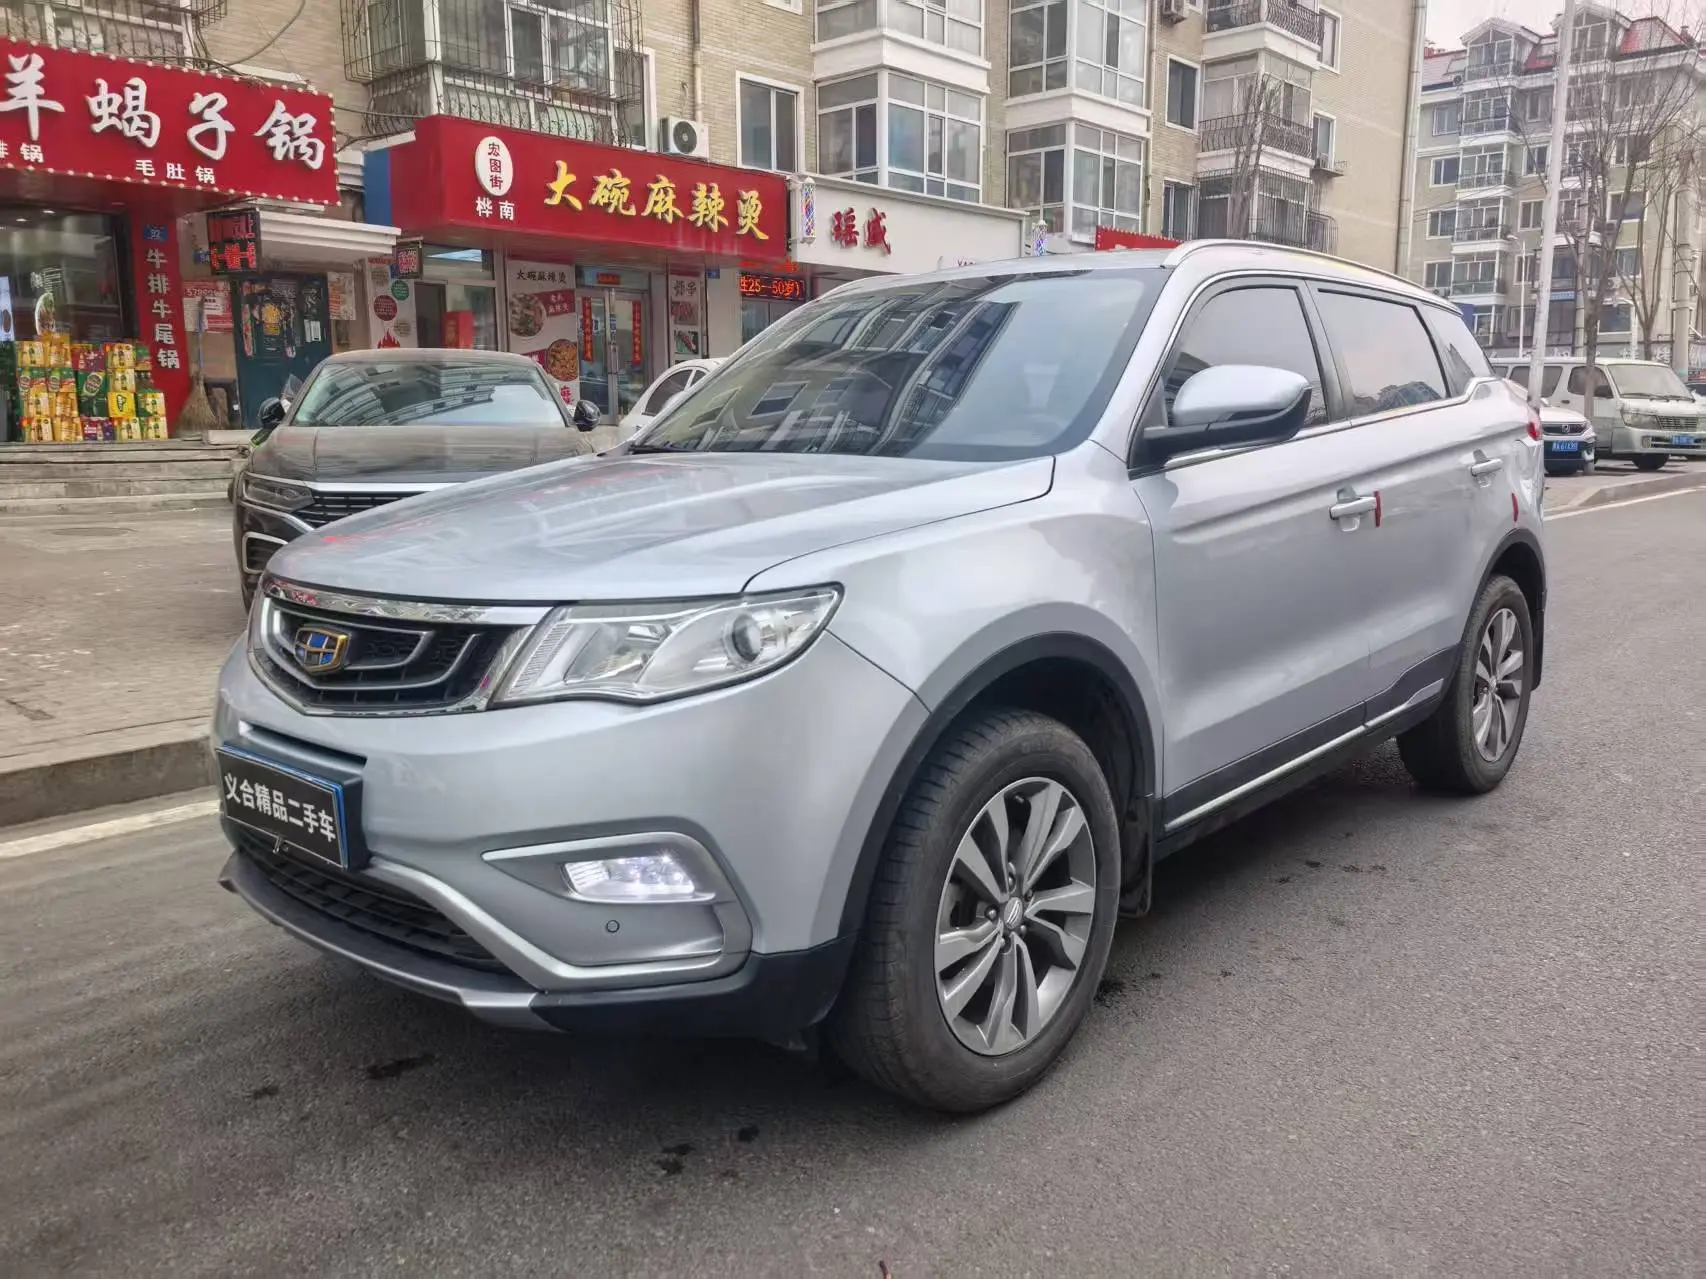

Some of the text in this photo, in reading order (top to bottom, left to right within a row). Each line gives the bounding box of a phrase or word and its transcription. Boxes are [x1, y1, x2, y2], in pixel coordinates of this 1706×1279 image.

[0, 53, 325, 170] 羊蝎子锅
[135, 158, 216, 185] 毛肚锅
[487, 141, 503, 190] 宏图街
[544, 159, 770, 241] 大碗麻辣烫
[475, 195, 515, 221] 桦南
[146, 247, 180, 369] 牛排牛尾锅
[224, 772, 336, 843] 义合精品二手车
